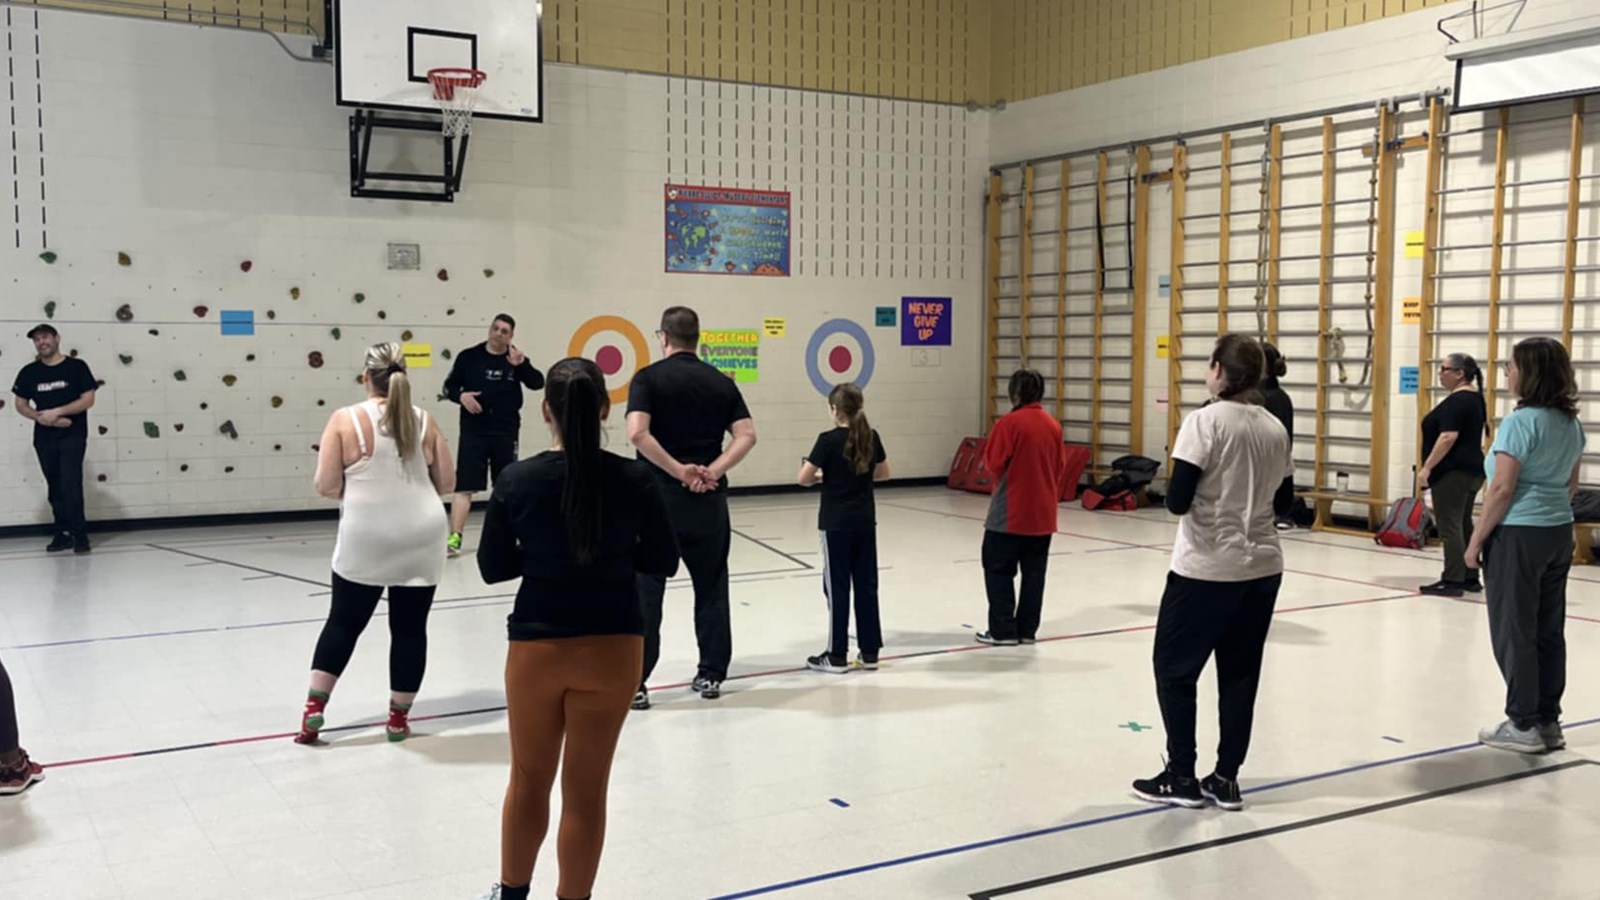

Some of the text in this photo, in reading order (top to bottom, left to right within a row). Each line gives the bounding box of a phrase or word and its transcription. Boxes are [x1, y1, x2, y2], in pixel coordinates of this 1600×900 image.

[908, 302, 943, 316] NEVER
[914, 315, 939, 328] GIVE
[701, 331, 758, 343] TOGETHER
[918, 328, 933, 340] UP
[701, 344, 758, 356] EVERYONE
[702, 355, 758, 369] ACHIEVES
